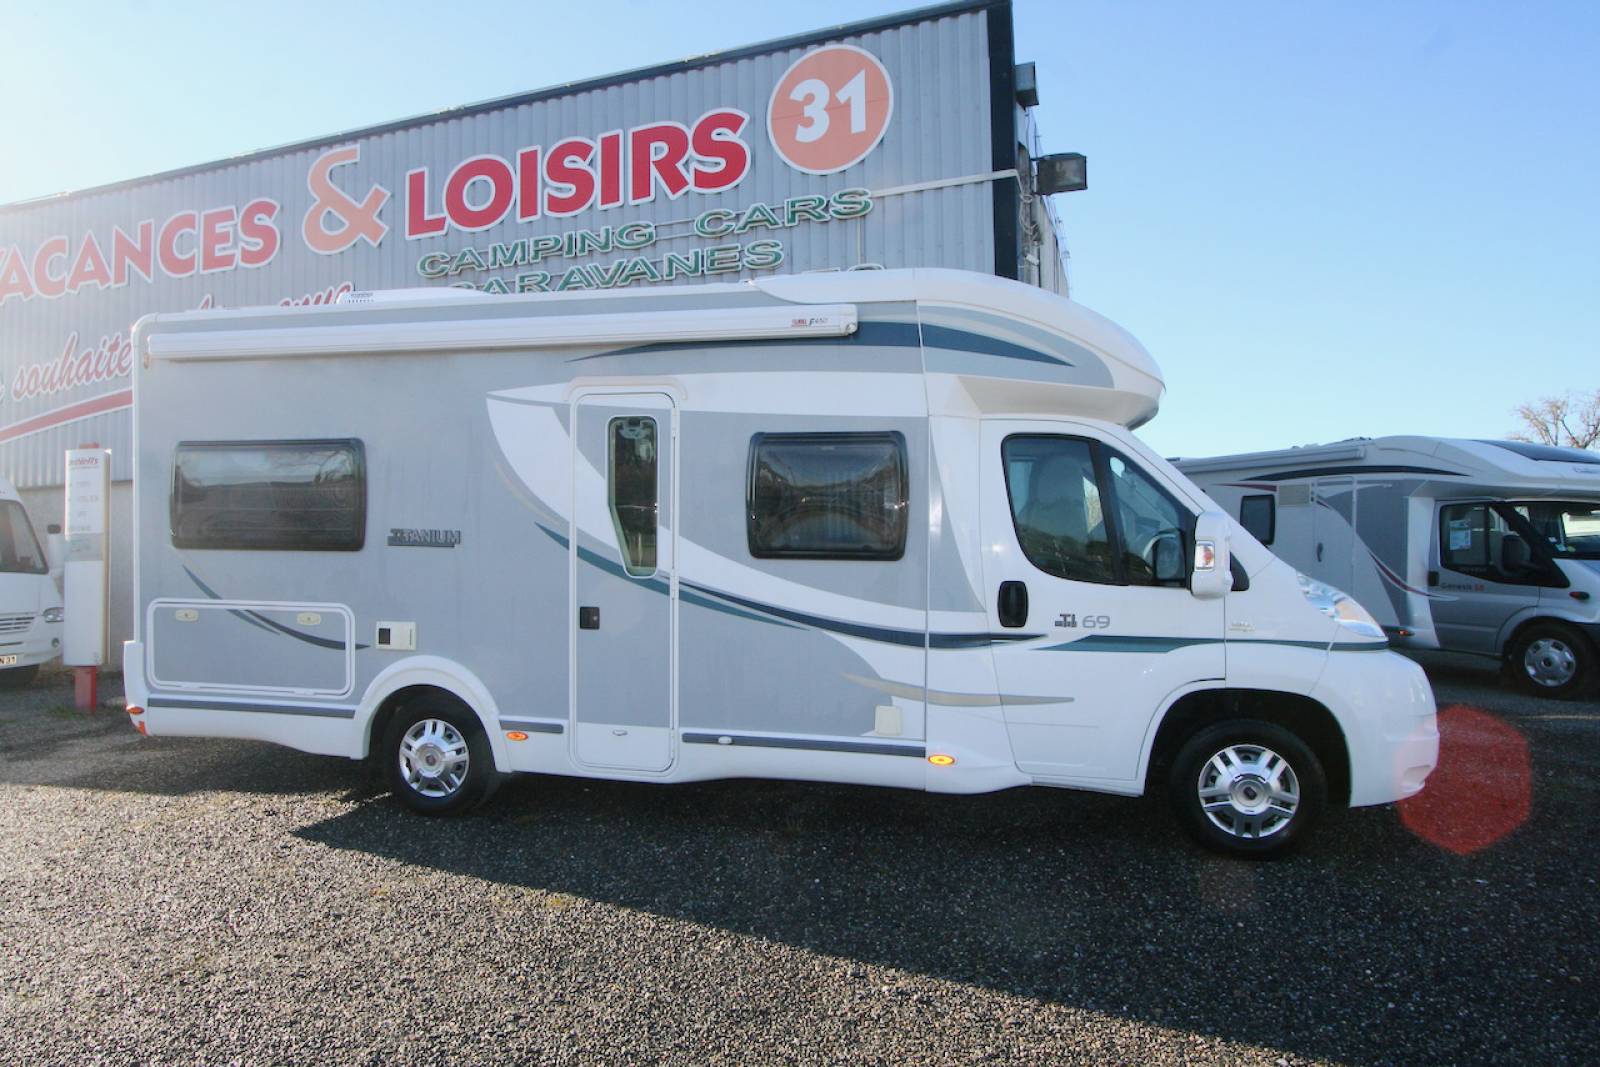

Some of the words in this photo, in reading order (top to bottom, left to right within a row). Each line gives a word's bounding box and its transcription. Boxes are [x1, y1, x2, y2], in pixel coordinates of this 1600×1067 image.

[789, 68, 867, 143] 31
[0, 199, 281, 305] ACANCES
[302, 144, 391, 255] &
[405, 108, 751, 240] LOISIRS
[416, 221, 656, 278] CAMPING
[694, 188, 874, 238] CARS
[450, 239, 784, 294] ARAVANES
[1082, 615, 1111, 629] 69
